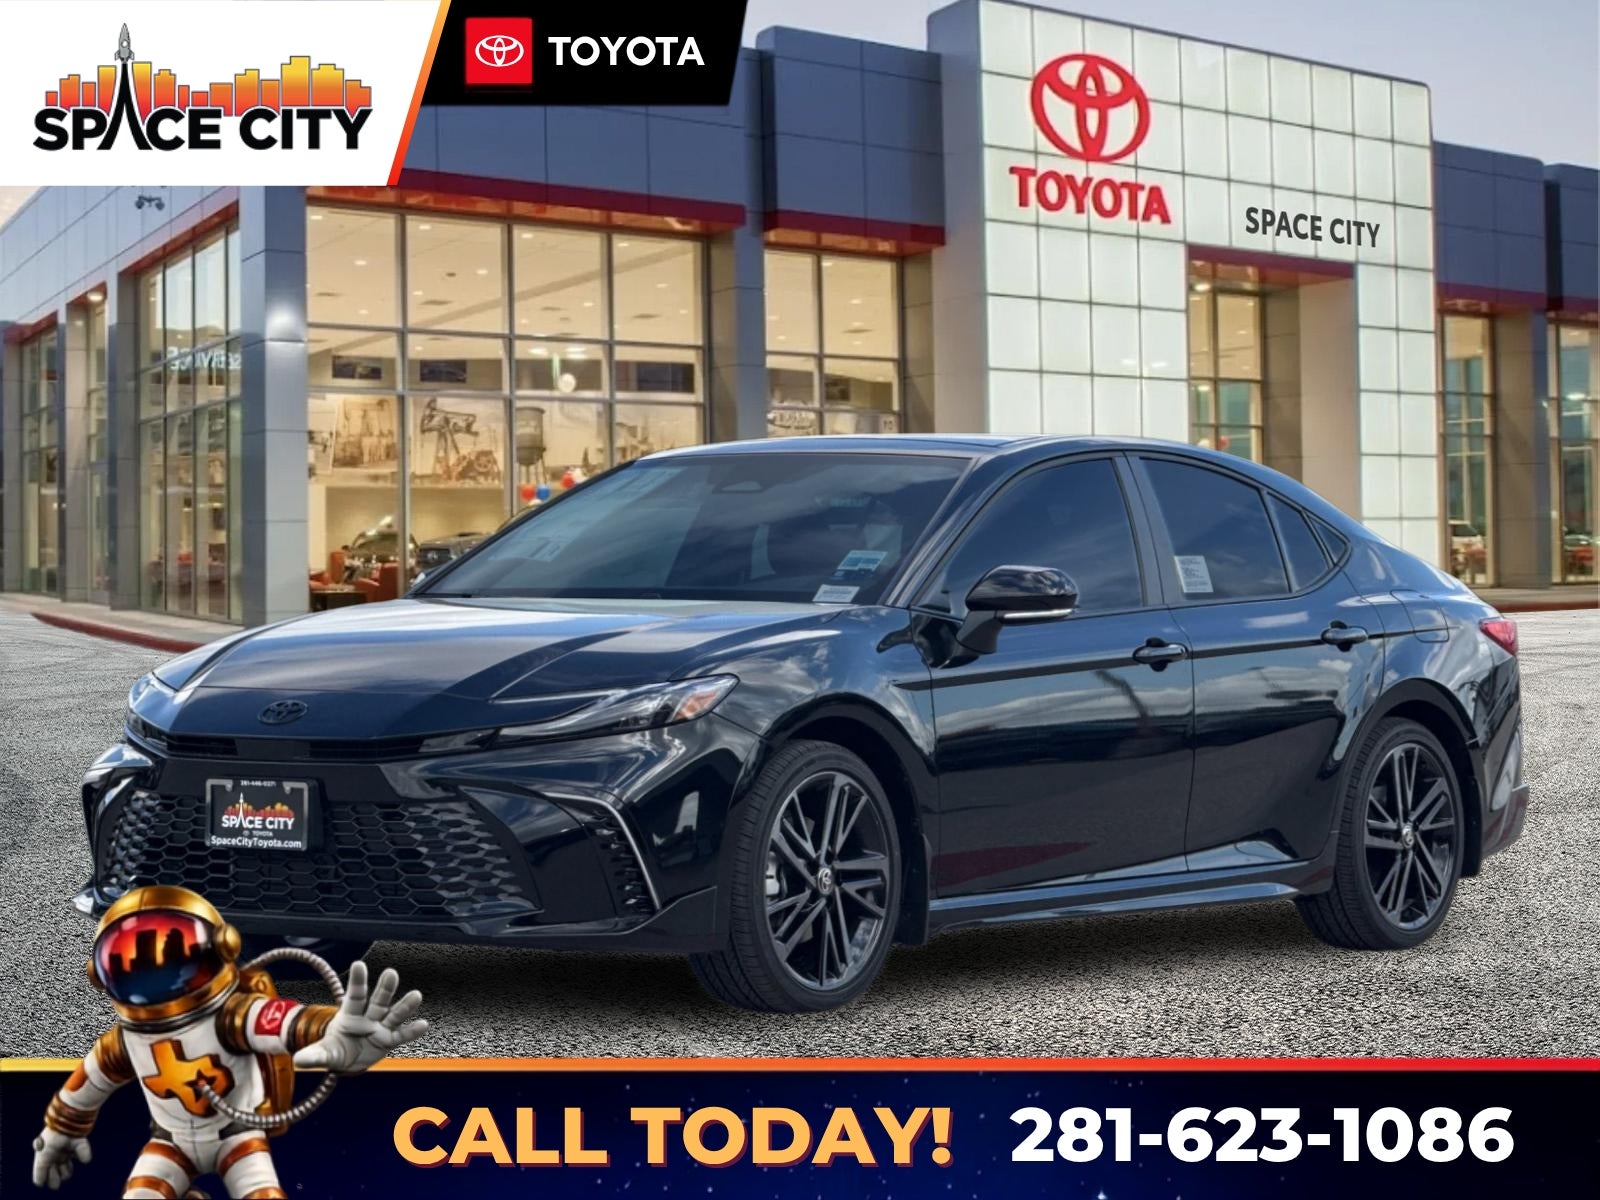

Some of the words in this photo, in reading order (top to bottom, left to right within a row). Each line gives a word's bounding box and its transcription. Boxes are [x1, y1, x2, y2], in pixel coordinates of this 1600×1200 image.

[1008, 166, 1172, 225] TOYOTA
[1245, 206, 1322, 242] SPACE
[1329, 217, 1381, 248] CITY
[222, 814, 263, 829] SPACE
[265, 816, 295, 830] CITY
[210, 835, 302, 848] SpaceCityToyota.com
